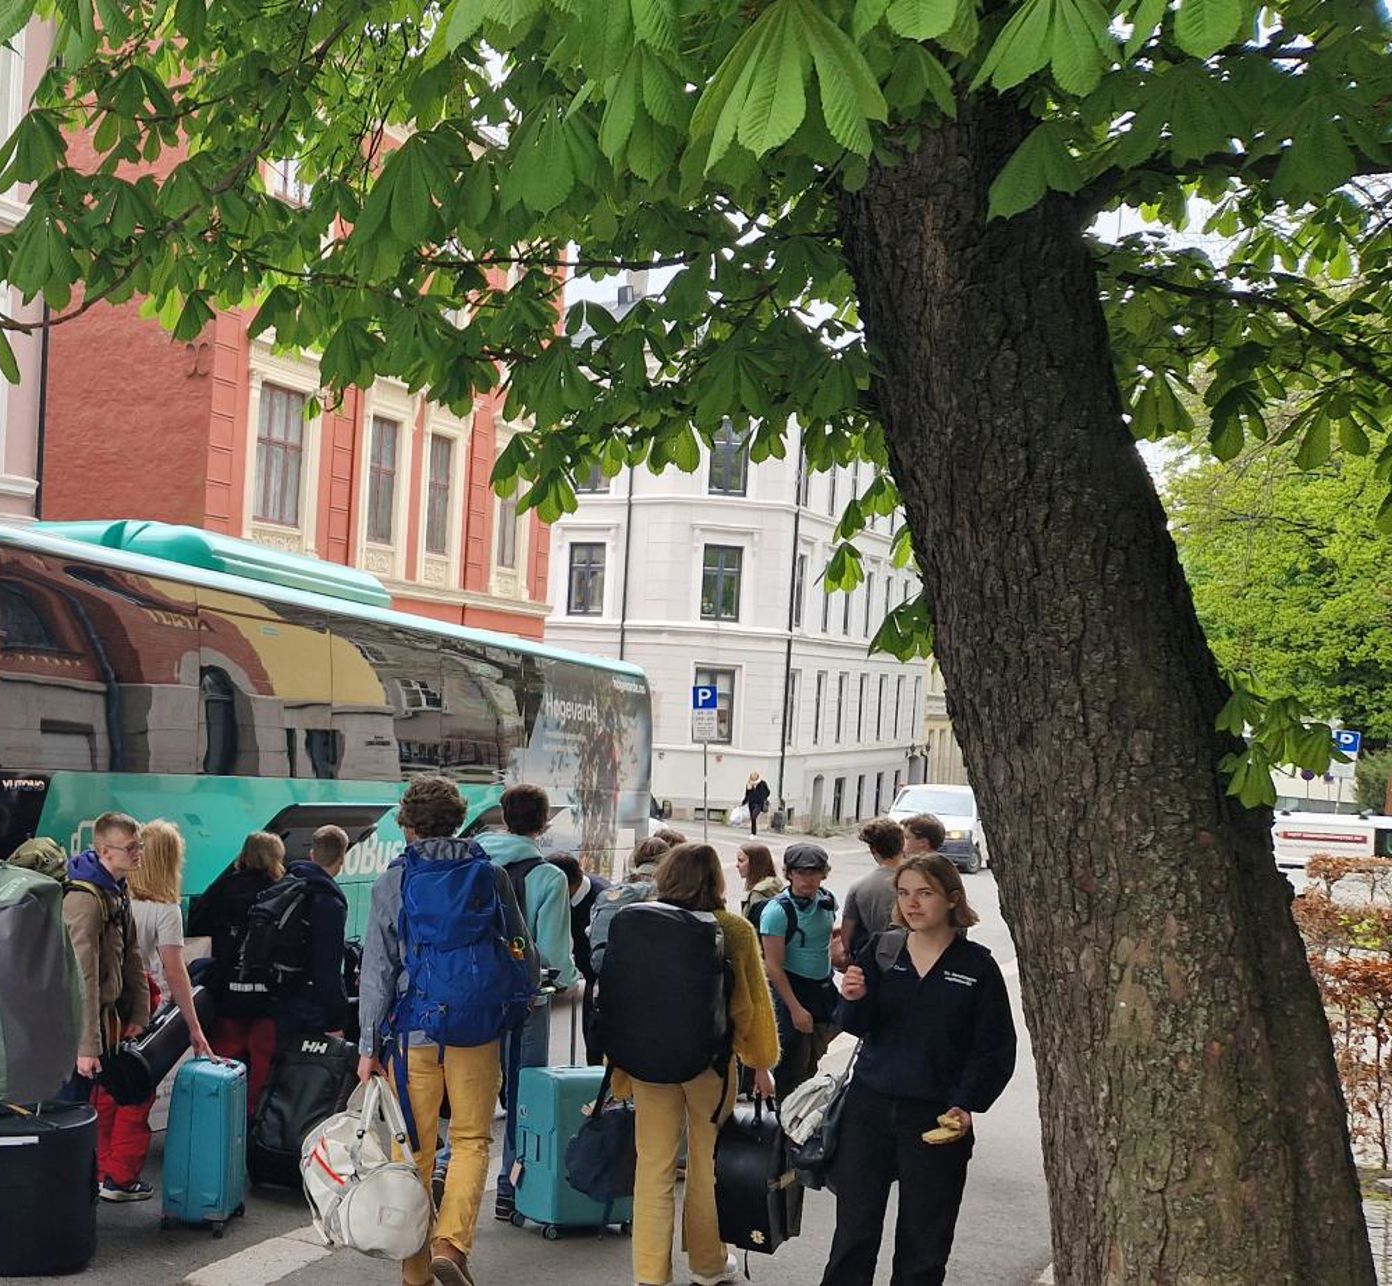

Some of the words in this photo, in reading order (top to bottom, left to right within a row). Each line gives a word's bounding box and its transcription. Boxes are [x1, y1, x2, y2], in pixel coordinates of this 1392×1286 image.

[698, 688, 712, 707] P
[1339, 733, 1354, 749] P
[301, 1040, 328, 1055] HH
